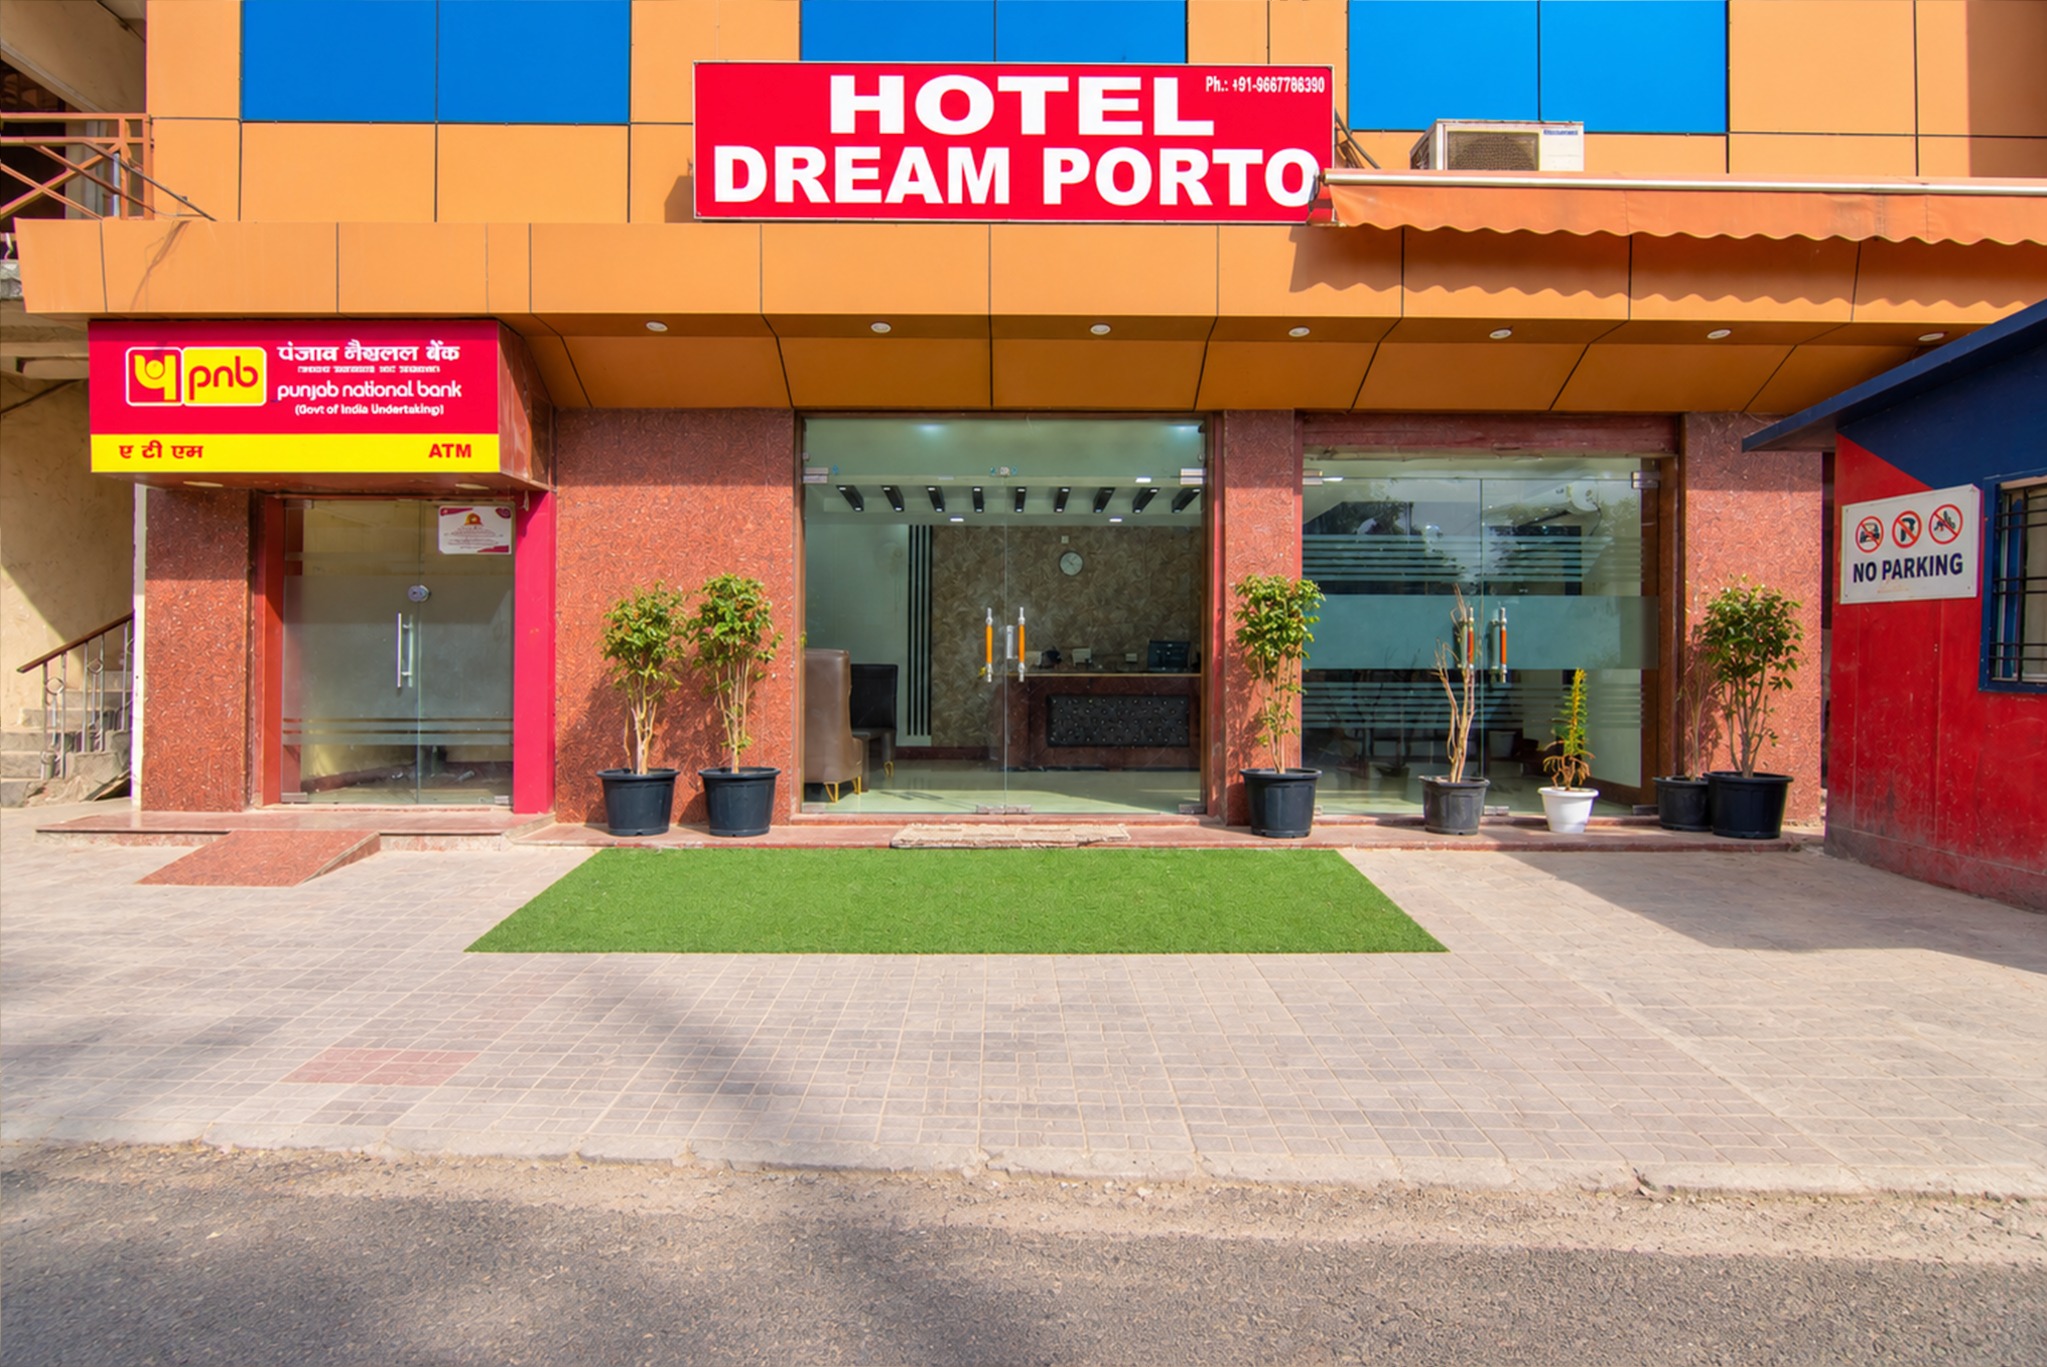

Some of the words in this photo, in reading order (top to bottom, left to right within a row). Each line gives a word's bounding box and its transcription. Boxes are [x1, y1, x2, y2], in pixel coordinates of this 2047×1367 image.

[1205, 76, 1229, 92] Ph.:
[829, 74, 1214, 137] HOTEL
[713, 145, 1010, 204] DREAM
[1042, 148, 1321, 208] PORTO
[188, 355, 259, 401] pnb
[277, 380, 339, 401] punjab
[342, 379, 414, 398] national
[417, 379, 462, 398] bank
[341, 404, 369, 415] India
[119, 445, 134, 459] ए
[141, 439, 162, 459] टी
[171, 445, 204, 459] एम
[428, 443, 472, 458] ATM
[1853, 561, 1877, 583] NO
[1881, 552, 1964, 581] PARKING
